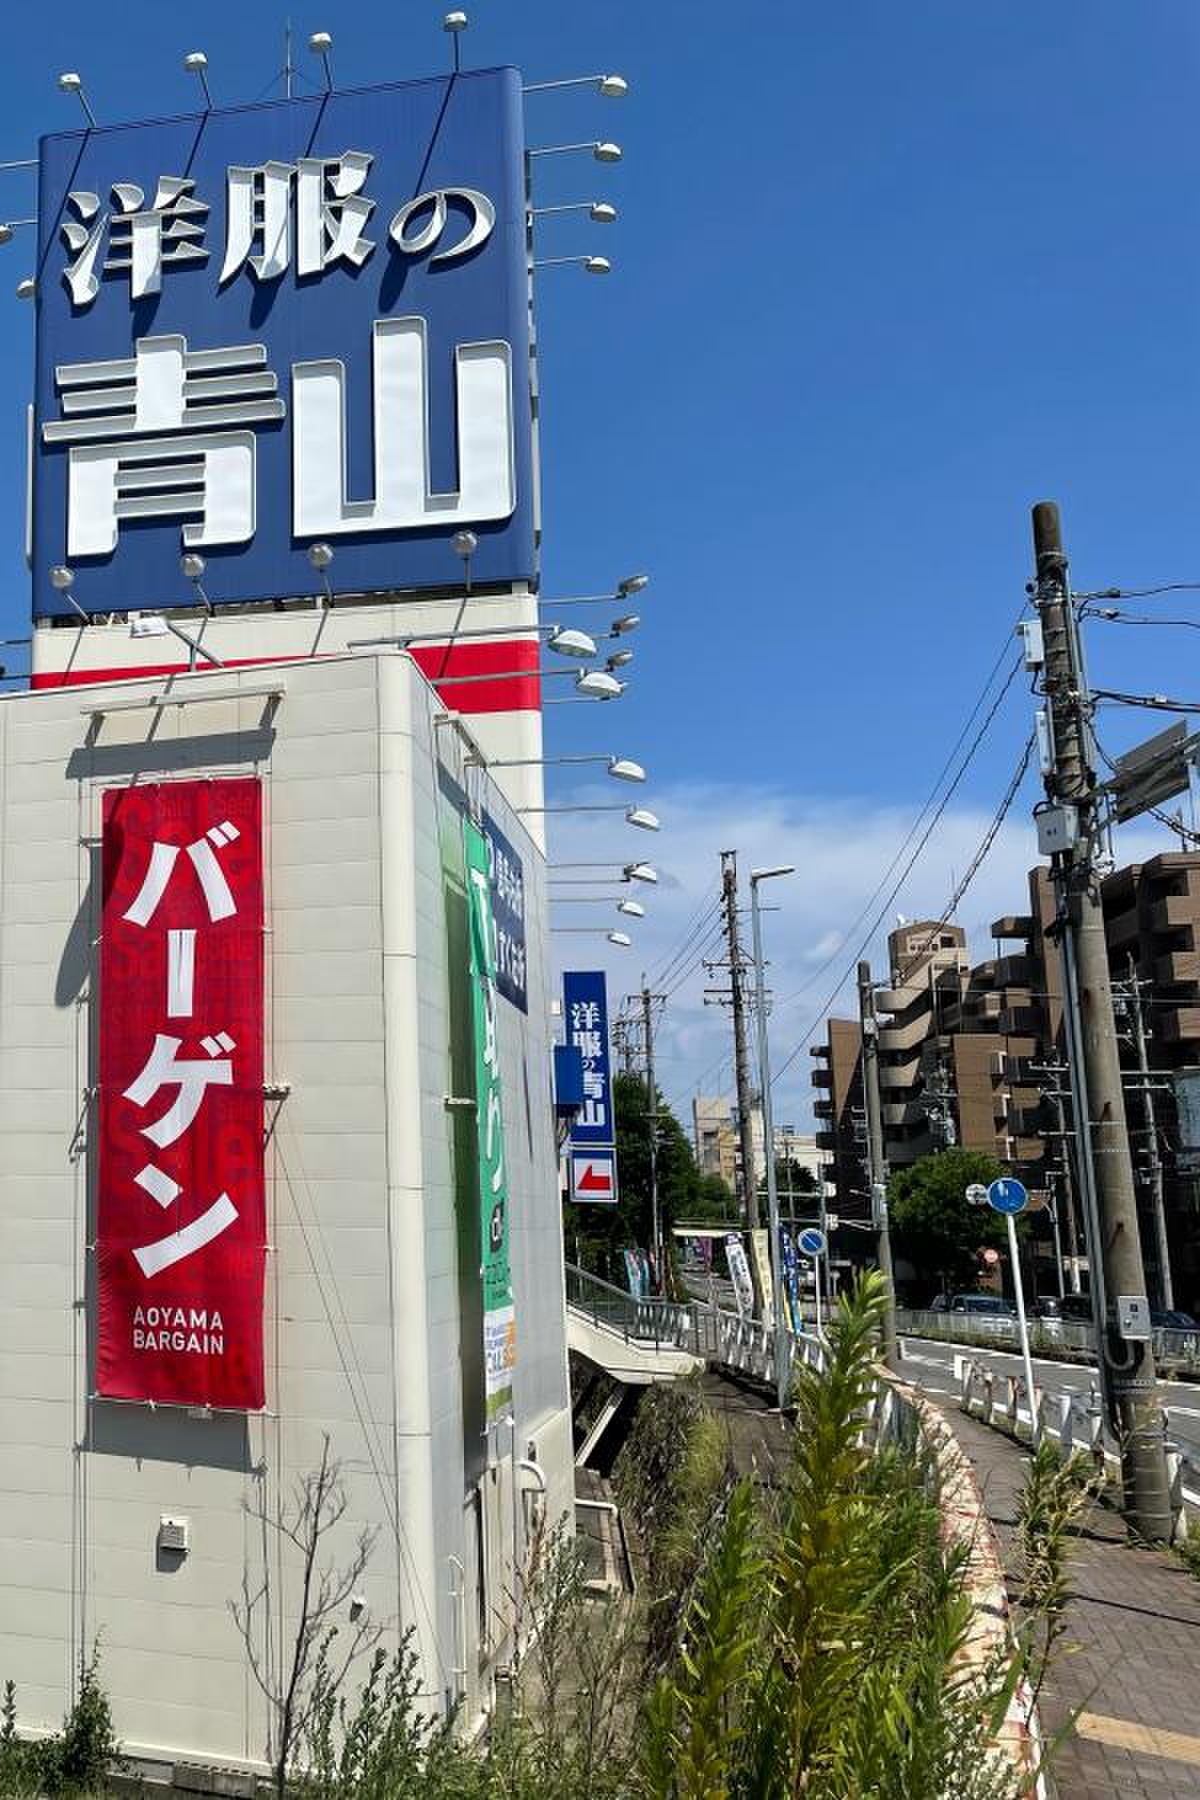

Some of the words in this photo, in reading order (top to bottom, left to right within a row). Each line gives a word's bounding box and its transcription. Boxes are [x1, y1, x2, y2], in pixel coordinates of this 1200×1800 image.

[60, 151, 496, 307] 洋服の
[42, 316, 517, 557] 青山
[122, 820, 241, 1280] バーゲン
[133, 1306, 224, 1330] AOYAMA
[133, 1329, 224, 1355] BARGAIN
